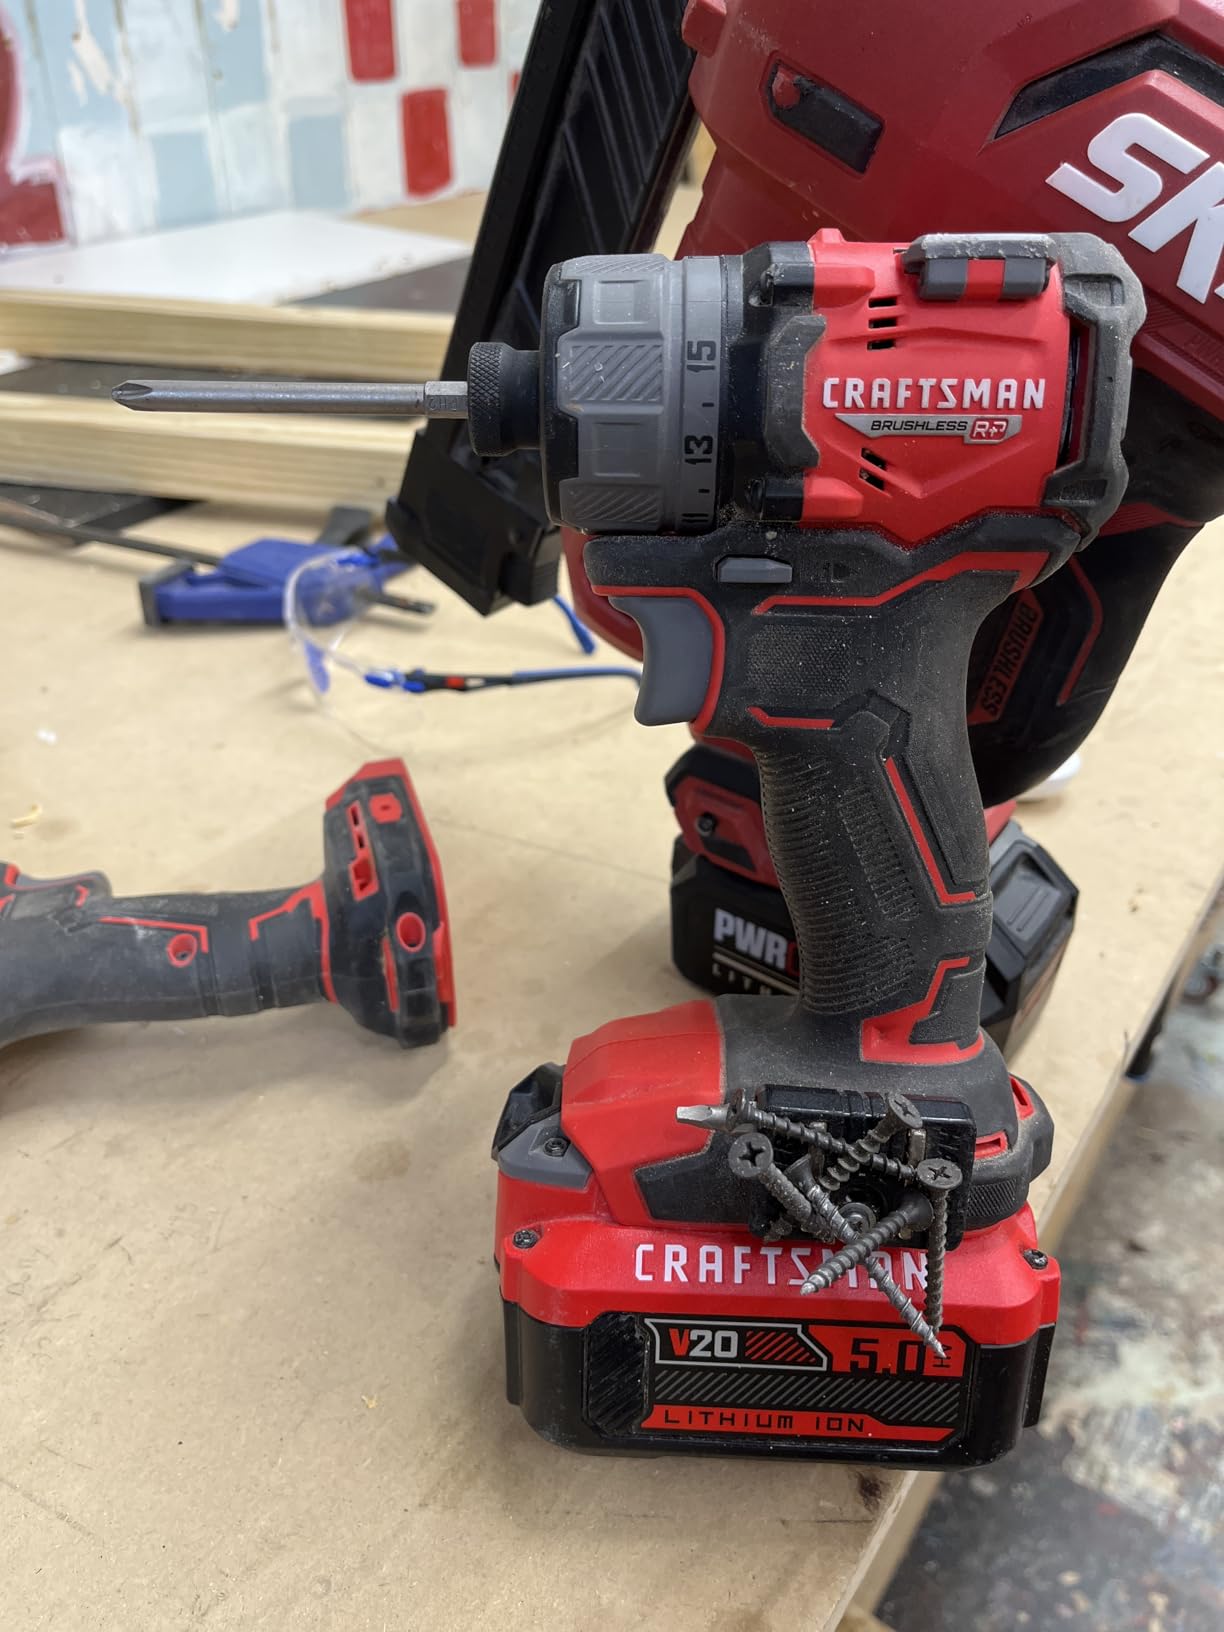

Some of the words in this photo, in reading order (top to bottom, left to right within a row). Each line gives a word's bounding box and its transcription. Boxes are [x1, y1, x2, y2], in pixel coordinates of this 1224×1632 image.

[687, 340, 716, 373] 15
[823, 377, 1045, 409] CRAFTSMAN
[870, 420, 967, 432] BRUSHLESS
[684, 435, 713, 465] 13
[981, 604, 1037, 714] BRUSHLESS
[668, 1327, 738, 1359] V20
[850, 1338, 926, 1375] 5.0
[665, 1410, 793, 1430] LITHIUM
[816, 1416, 864, 1433] ION
